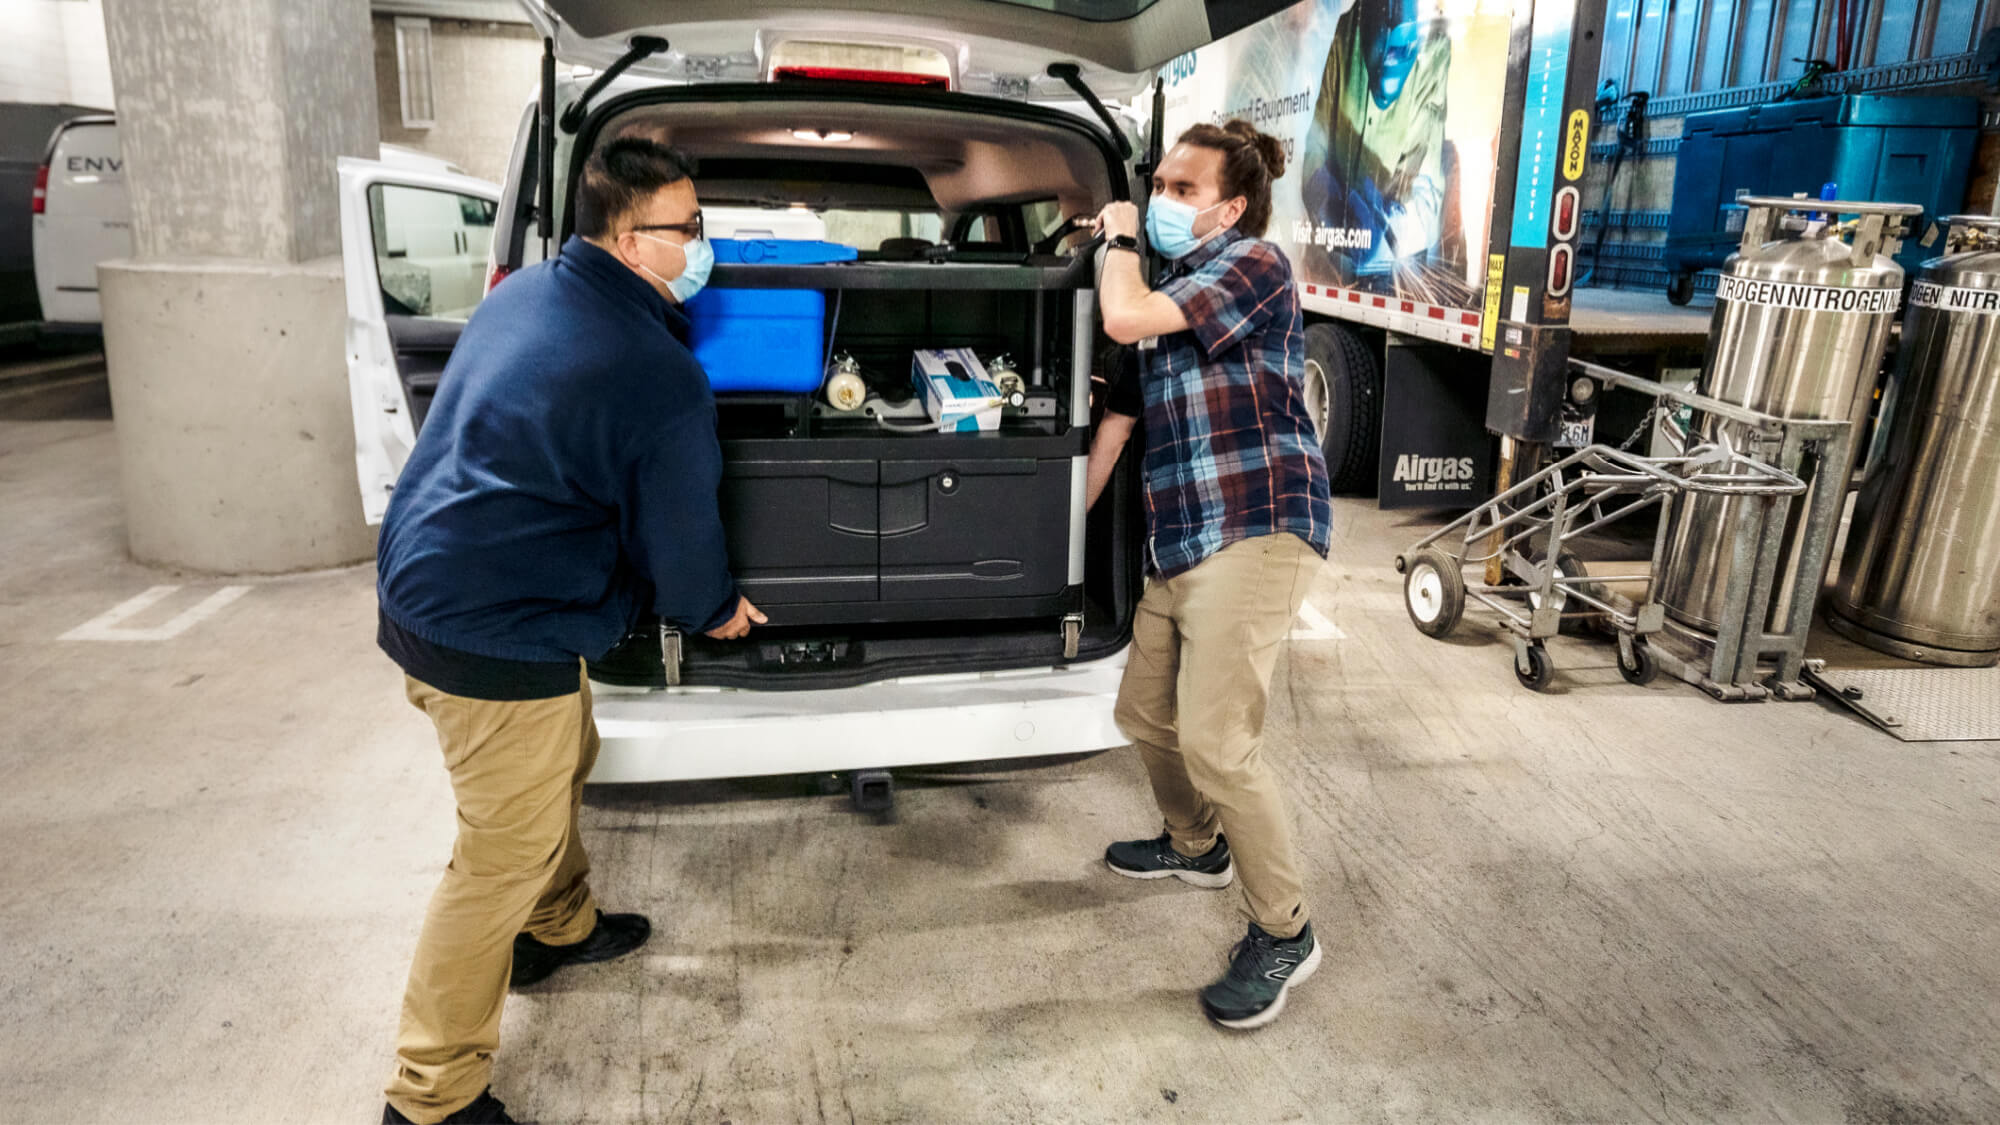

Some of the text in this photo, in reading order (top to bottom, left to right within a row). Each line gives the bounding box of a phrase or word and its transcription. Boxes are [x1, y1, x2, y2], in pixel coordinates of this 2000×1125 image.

[1256, 86, 1310, 127] Equipment
[1569, 119, 1583, 172] MAXON
[1292, 220, 1312, 245] Visit
[1315, 221, 1372, 252] airgas.com
[1789, 285, 1888, 312] NITROGEN
[1950, 289, 2000, 310] NITR
[1393, 454, 1474, 483] Airgas
